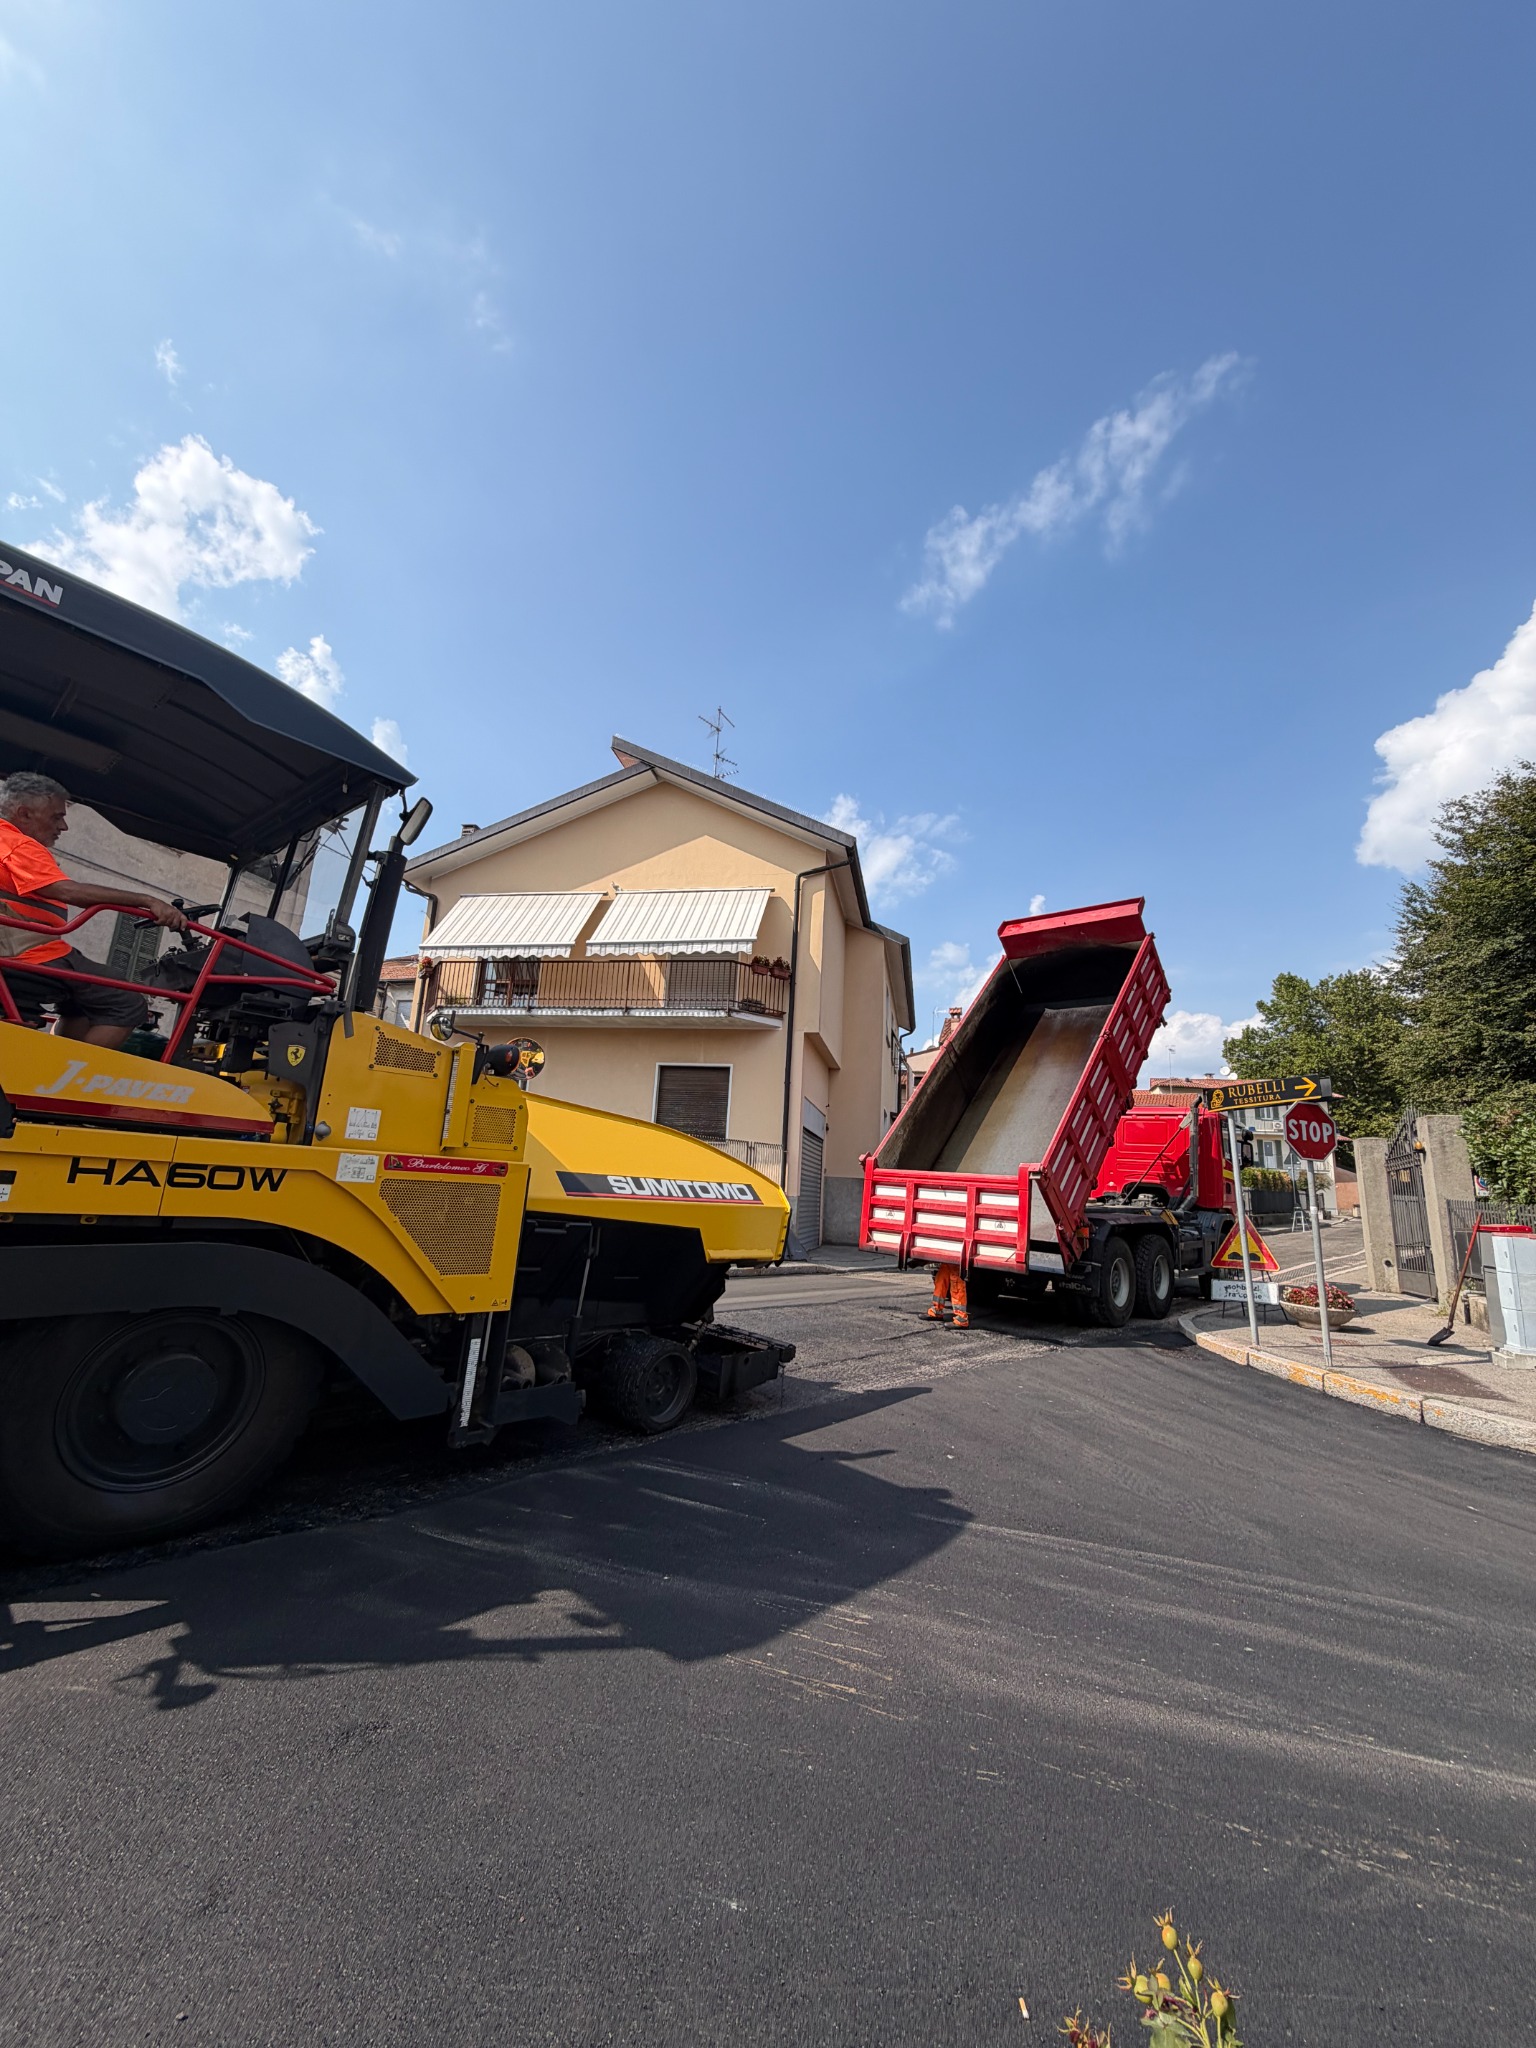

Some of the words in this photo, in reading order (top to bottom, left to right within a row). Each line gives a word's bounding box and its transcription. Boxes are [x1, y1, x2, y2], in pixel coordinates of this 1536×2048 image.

[1228, 1080, 1286, 1098] RUBELLI
[1233, 1093, 1282, 1105] TESSITURA
[1288, 1118, 1333, 1144] STOP
[66, 1156, 289, 1193] HA60W
[407, 1158, 470, 1171] Bartolomeo
[606, 1175, 754, 1201] SUMITOMO
